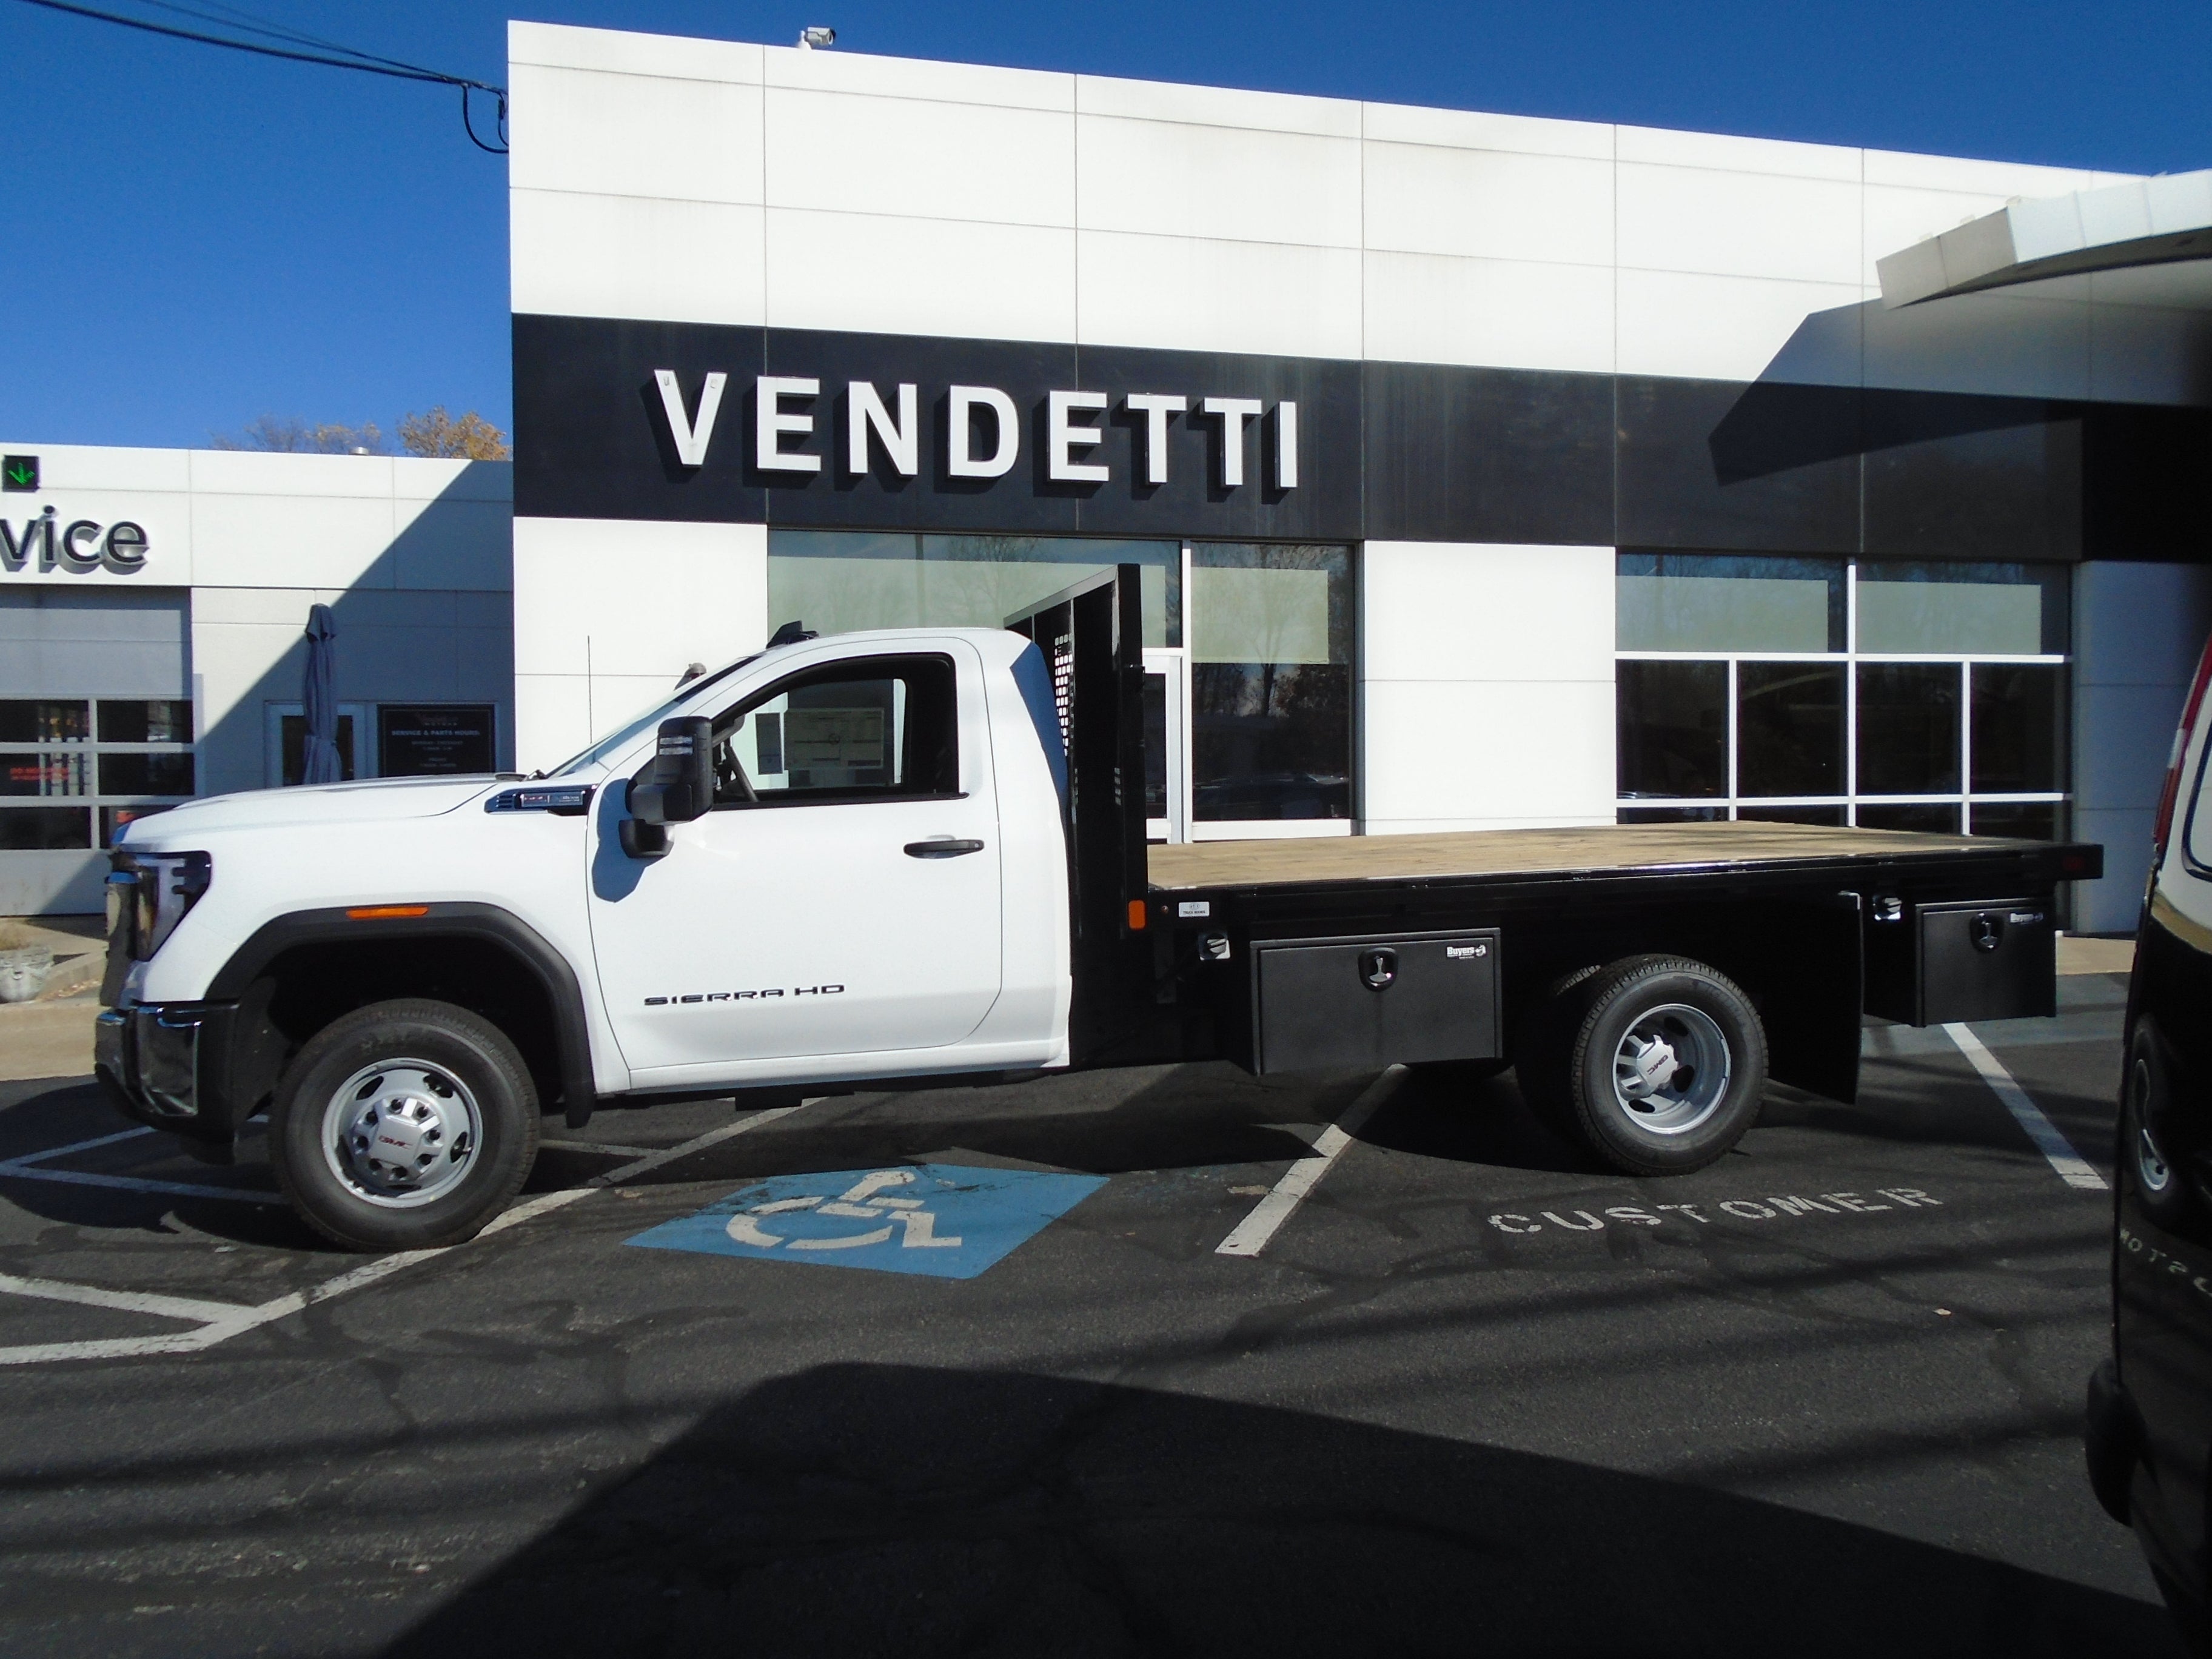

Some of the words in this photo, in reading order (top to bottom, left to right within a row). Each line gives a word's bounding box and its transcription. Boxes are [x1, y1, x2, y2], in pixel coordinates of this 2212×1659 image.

[654, 368, 1298, 489] VENDETTI
[0, 504, 150, 564] vice
[1446, 947, 1475, 957] Buyers
[644, 988, 785, 1006] SIERRA
[794, 984, 845, 996] HD
[1646, 1054, 1669, 1076] GMC
[1487, 1187, 1944, 1233] CUSTOMER
